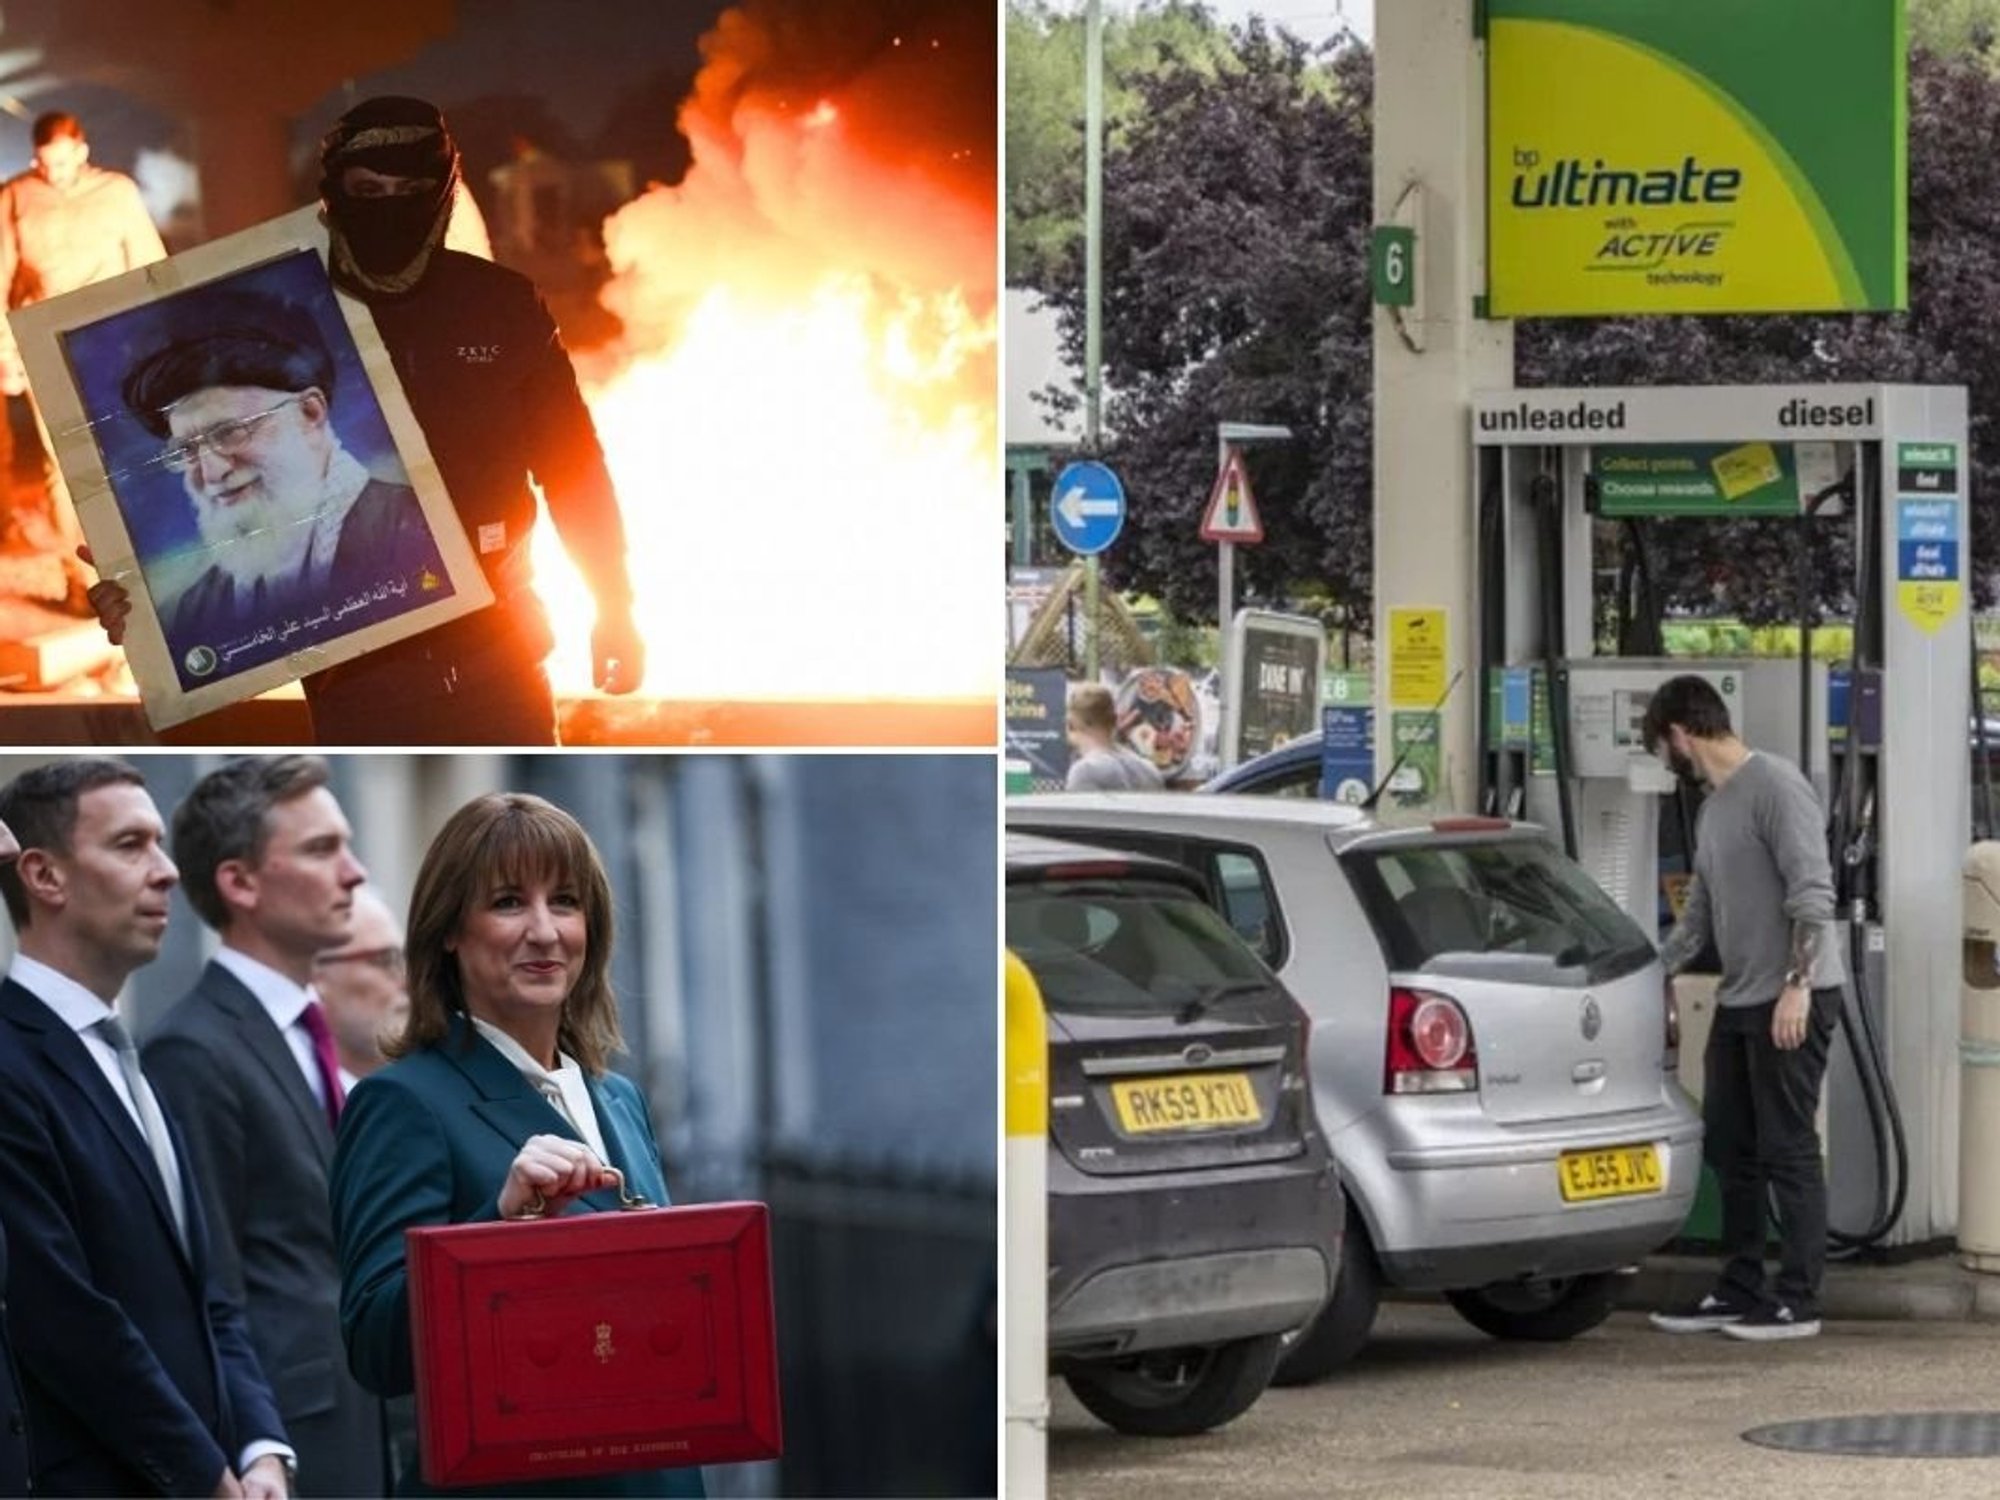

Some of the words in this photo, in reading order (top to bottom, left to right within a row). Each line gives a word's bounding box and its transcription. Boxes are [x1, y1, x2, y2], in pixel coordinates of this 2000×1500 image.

[1513, 146, 1540, 171] bp
[1511, 156, 1741, 208] ultimate
[1603, 217, 1637, 230] with
[1596, 231, 1722, 258] ACTIVE
[1386, 242, 1403, 284] 6
[1645, 270, 1723, 286] technology
[1479, 401, 1626, 431] unleaded
[1779, 396, 1873, 426] diesel
[1721, 676, 1736, 696] 6
[1129, 1085, 1200, 1126] RK59
[1201, 1081, 1249, 1119] XTU
[1567, 1153, 1621, 1190] EJ55
